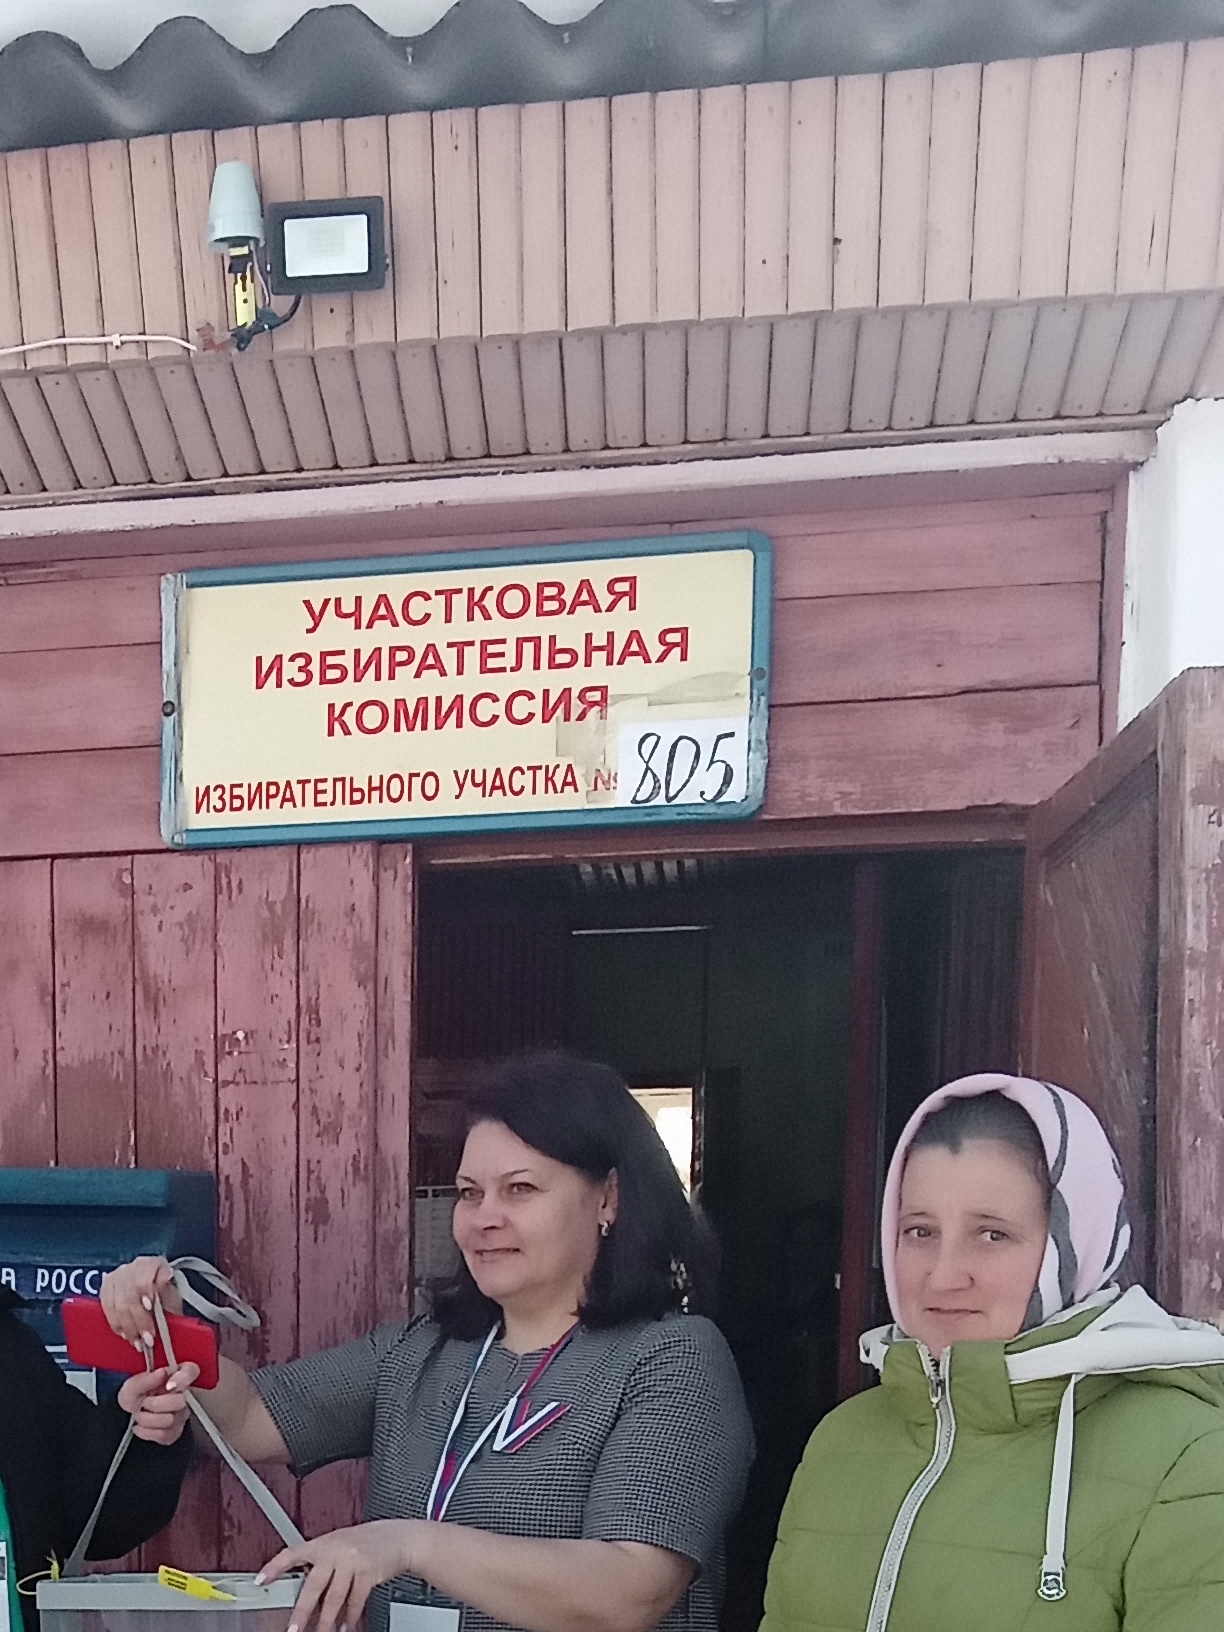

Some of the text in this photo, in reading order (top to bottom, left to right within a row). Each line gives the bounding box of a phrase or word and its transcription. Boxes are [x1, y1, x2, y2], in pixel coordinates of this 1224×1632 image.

[303, 576, 638, 633] УЧАСТКОВАЯ
[255, 627, 689, 690] ИЗБИРАТЕЛЬНАЯ
[326, 685, 609, 737] КОМИССИЯ
[195, 770, 440, 815] ИЗБИРАТЕЛЬНОГО
[454, 763, 578, 802] УЧАСТКА
[630, 731, 736, 804] 805
[36, 1268, 106, 1294] РОСС
